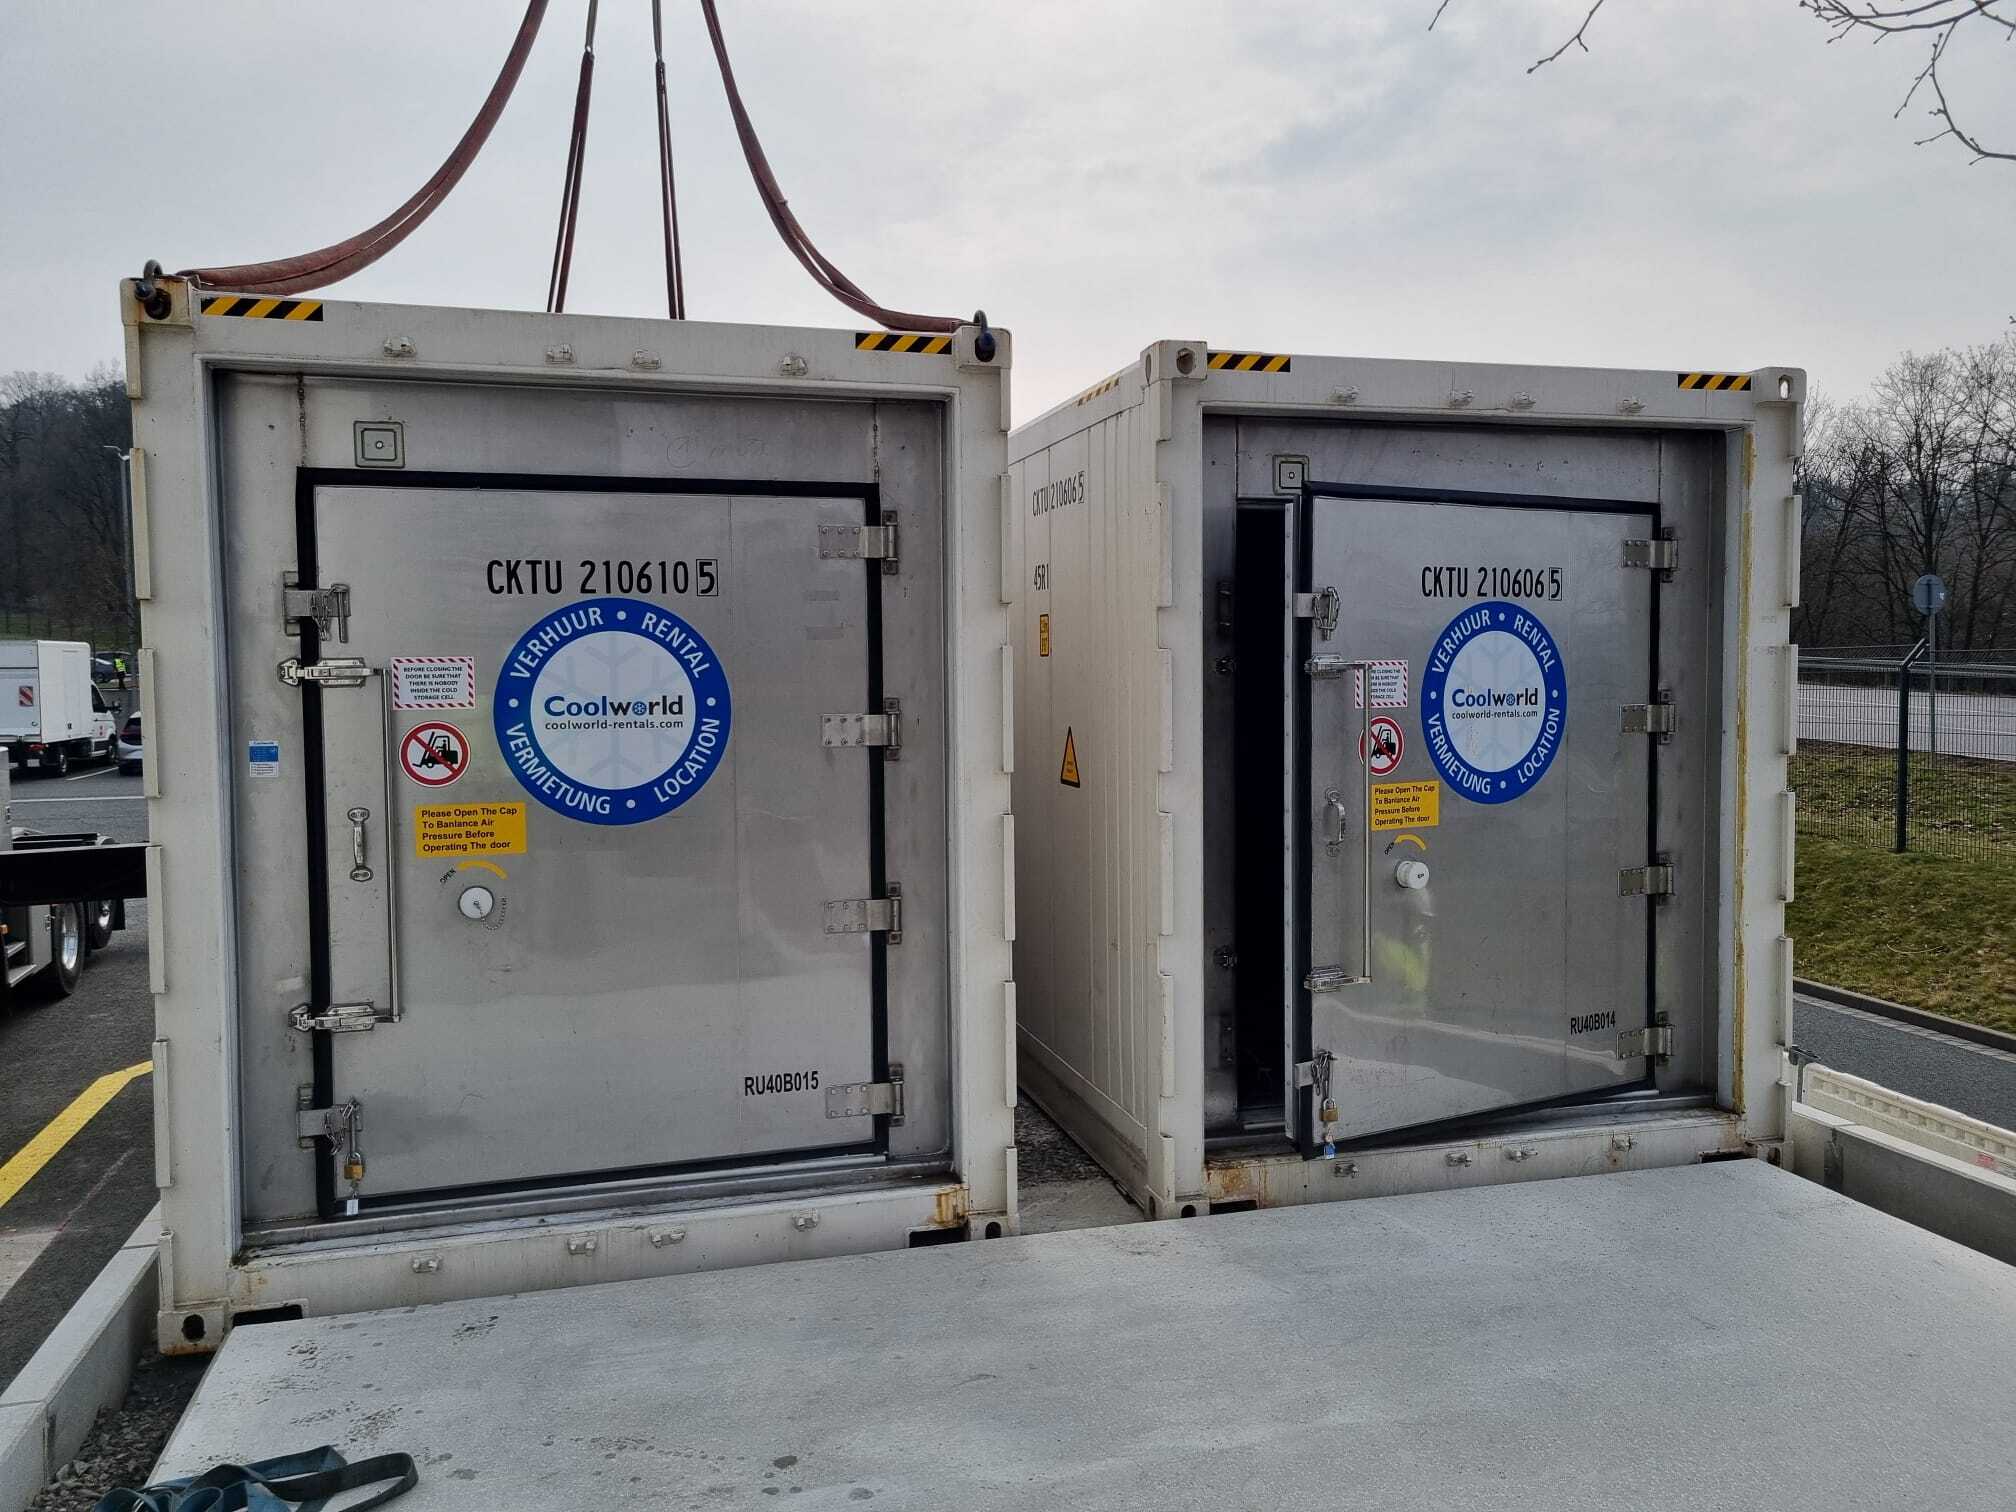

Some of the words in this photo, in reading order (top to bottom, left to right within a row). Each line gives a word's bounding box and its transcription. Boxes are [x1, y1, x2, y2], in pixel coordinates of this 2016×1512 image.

[1032, 486, 1049, 517] CKTU
[1050, 475, 1077, 510] 210606
[487, 560, 563, 595] CKTU
[579, 560, 689, 594] 210610
[698, 560, 717, 596] 5
[1034, 563, 1049, 591] 45R1
[1421, 566, 1468, 597] CKTU
[1477, 567, 1545, 598] 210606
[1549, 568, 1562, 599] 5
[510, 607, 604, 680] VERHUUR
[641, 612, 711, 679] RENTAL
[1432, 609, 1491, 674] VERHUUR
[1513, 614, 1556, 673] RENTAL
[544, 695, 683, 717] Coolworld
[1452, 687, 1538, 708] Coolworld
[545, 719, 684, 731] coolworld-rentals.com
[1452, 709, 1538, 720] coolworld-rentals.com
[1427, 712, 1491, 795] VERMIETUNG
[1517, 708, 1561, 784] LOCATION
[506, 722, 610, 814] VERMIETUNG
[653, 717, 720, 804] LOCATION
[1374, 787, 1394, 795] Please
[1395, 786, 1411, 795] Open
[1412, 785, 1423, 793] The
[1424, 784, 1436, 793] Cap
[1412, 795, 1420, 803] Air
[421, 809, 452, 818] Please
[454, 808, 478, 818] Open
[480, 807, 497, 815] The
[499, 807, 518, 817] Cap
[422, 821, 434, 829] To
[436, 820, 479, 829] Banlance
[481, 818, 495, 827] Air
[1375, 817, 1404, 826] Operating
[1417, 815, 1430, 823] door
[1401, 806, 1421, 814] Before
[422, 832, 463, 841] Pressure
[465, 830, 495, 839] Before
[423, 843, 468, 854] Operating
[490, 841, 512, 849] door
[1570, 1009, 1616, 1036] RU40B014
[744, 1070, 819, 1097] RU40B015
